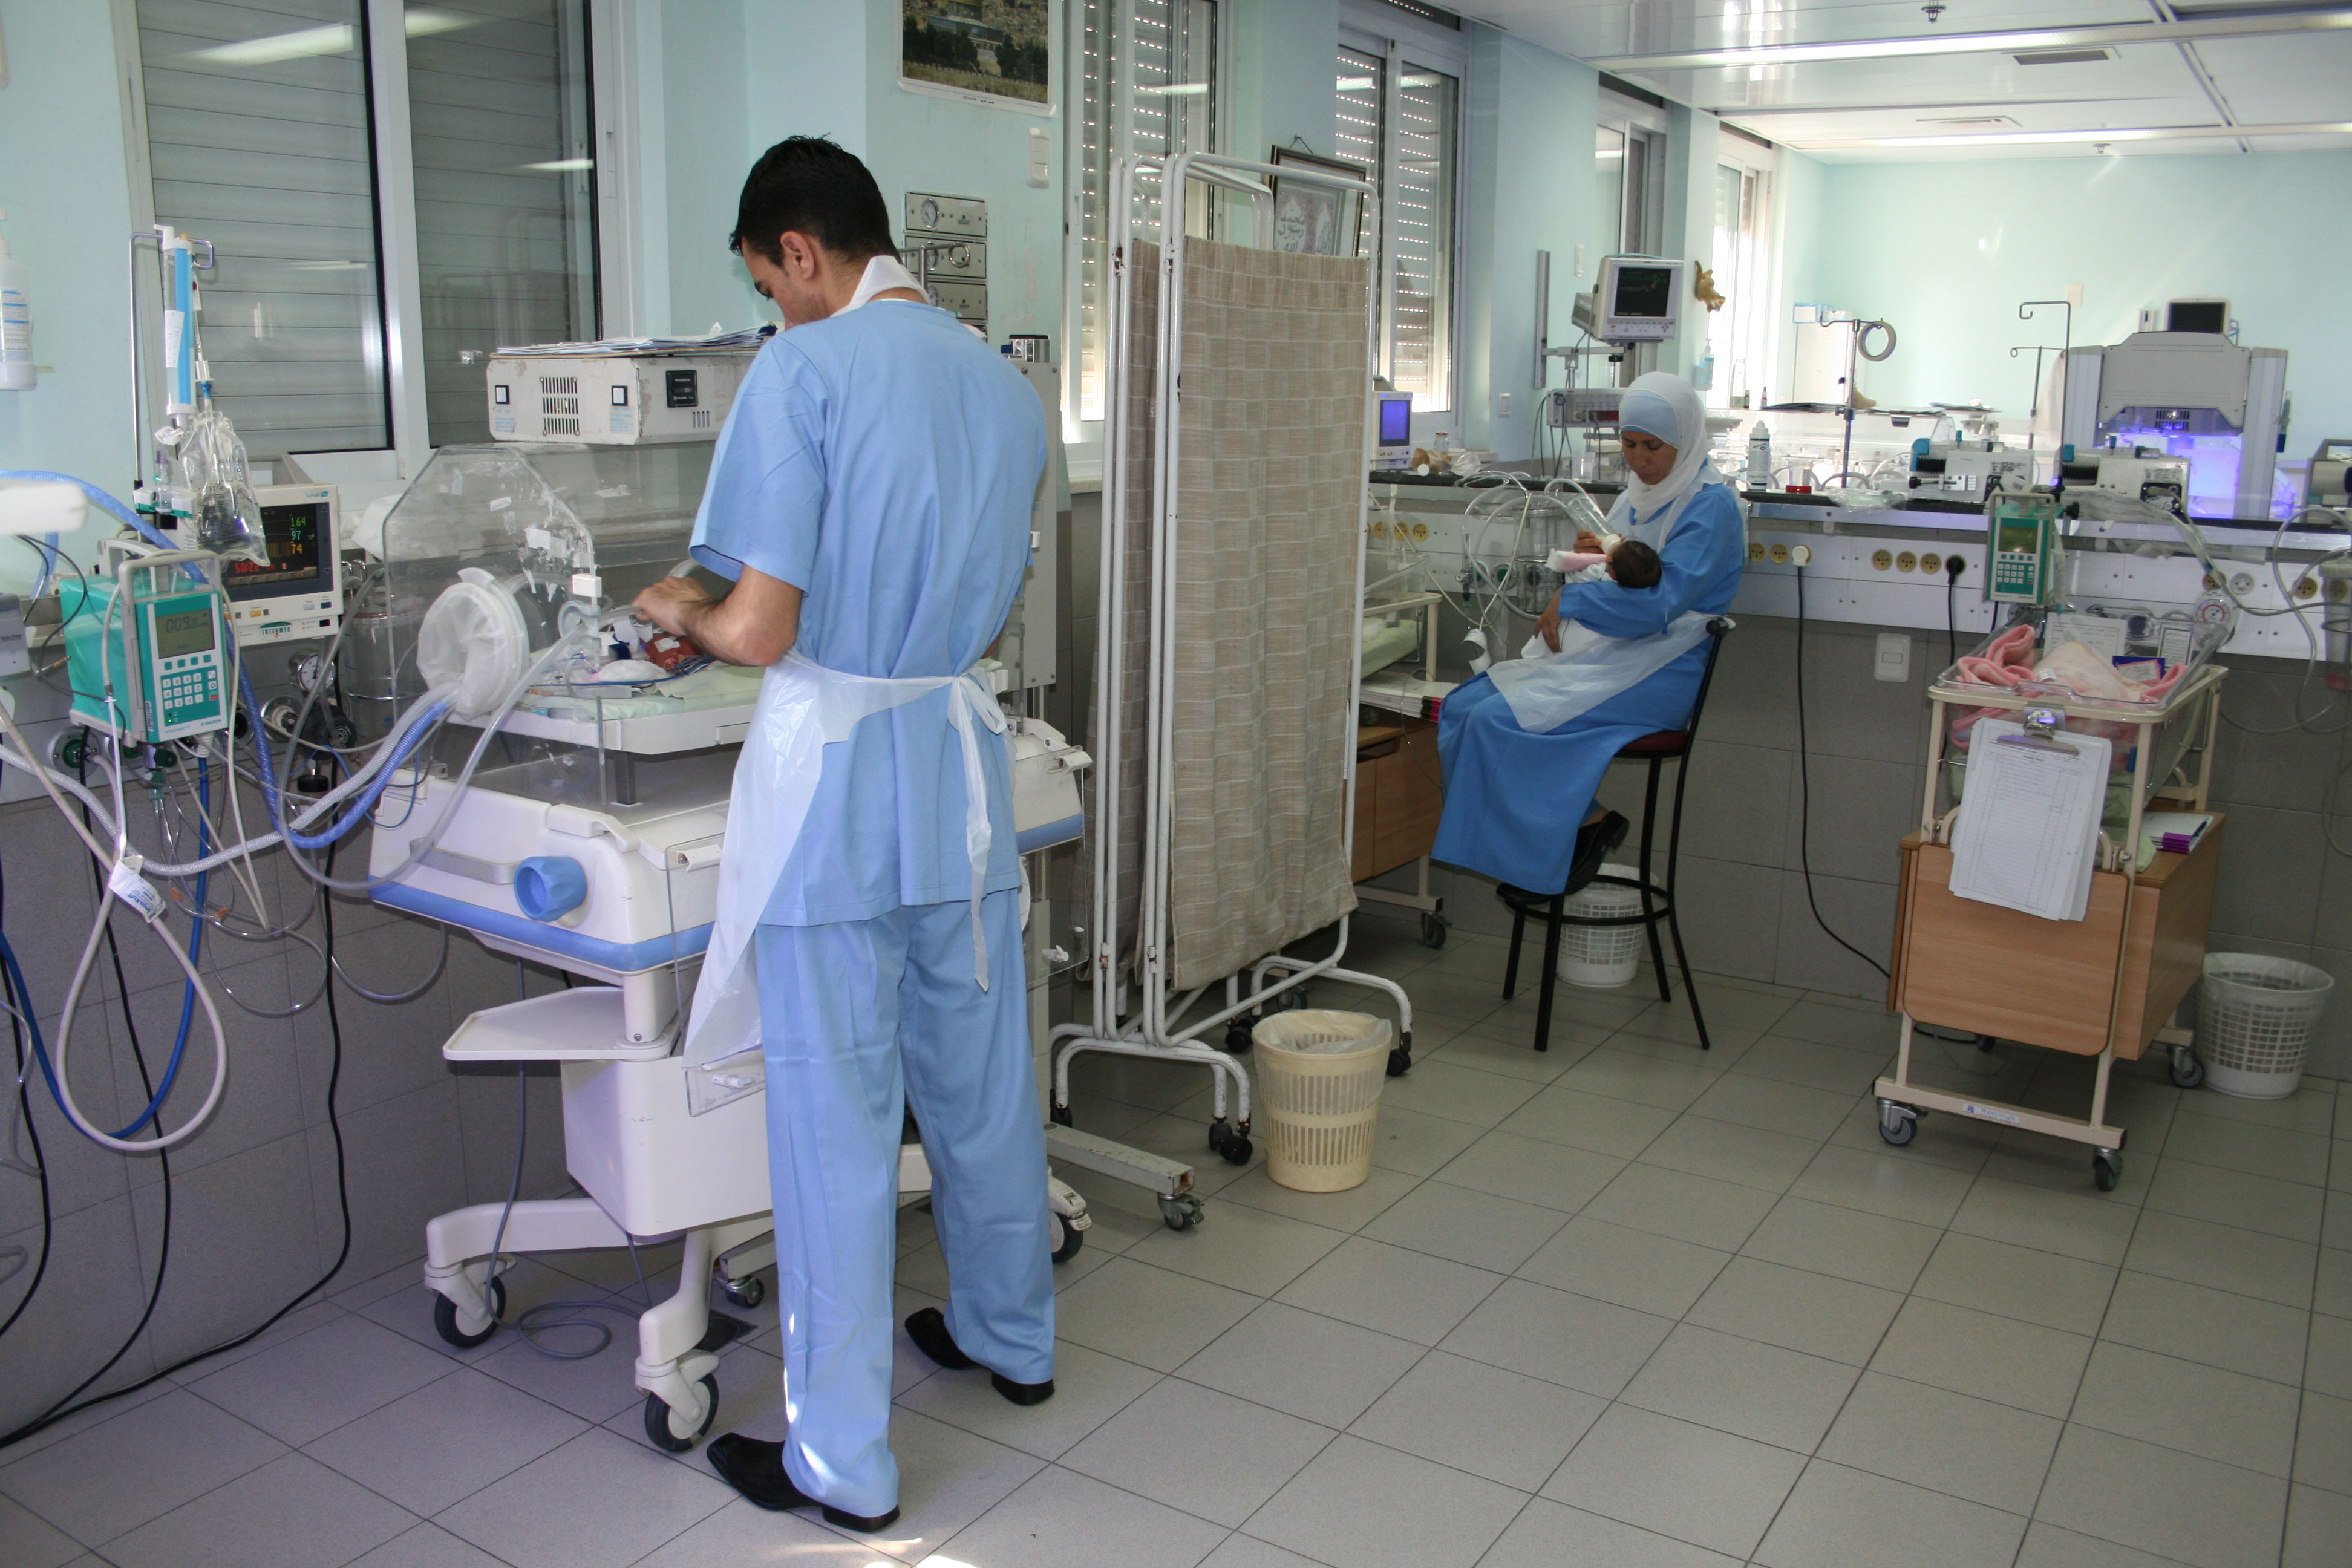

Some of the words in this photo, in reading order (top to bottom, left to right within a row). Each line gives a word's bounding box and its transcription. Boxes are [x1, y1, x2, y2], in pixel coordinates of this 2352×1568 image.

[290, 517, 307, 527] 164
[291, 531, 301, 541] 97
[291, 544, 302, 554] 74
[262, 627, 291, 635] INTERMED
